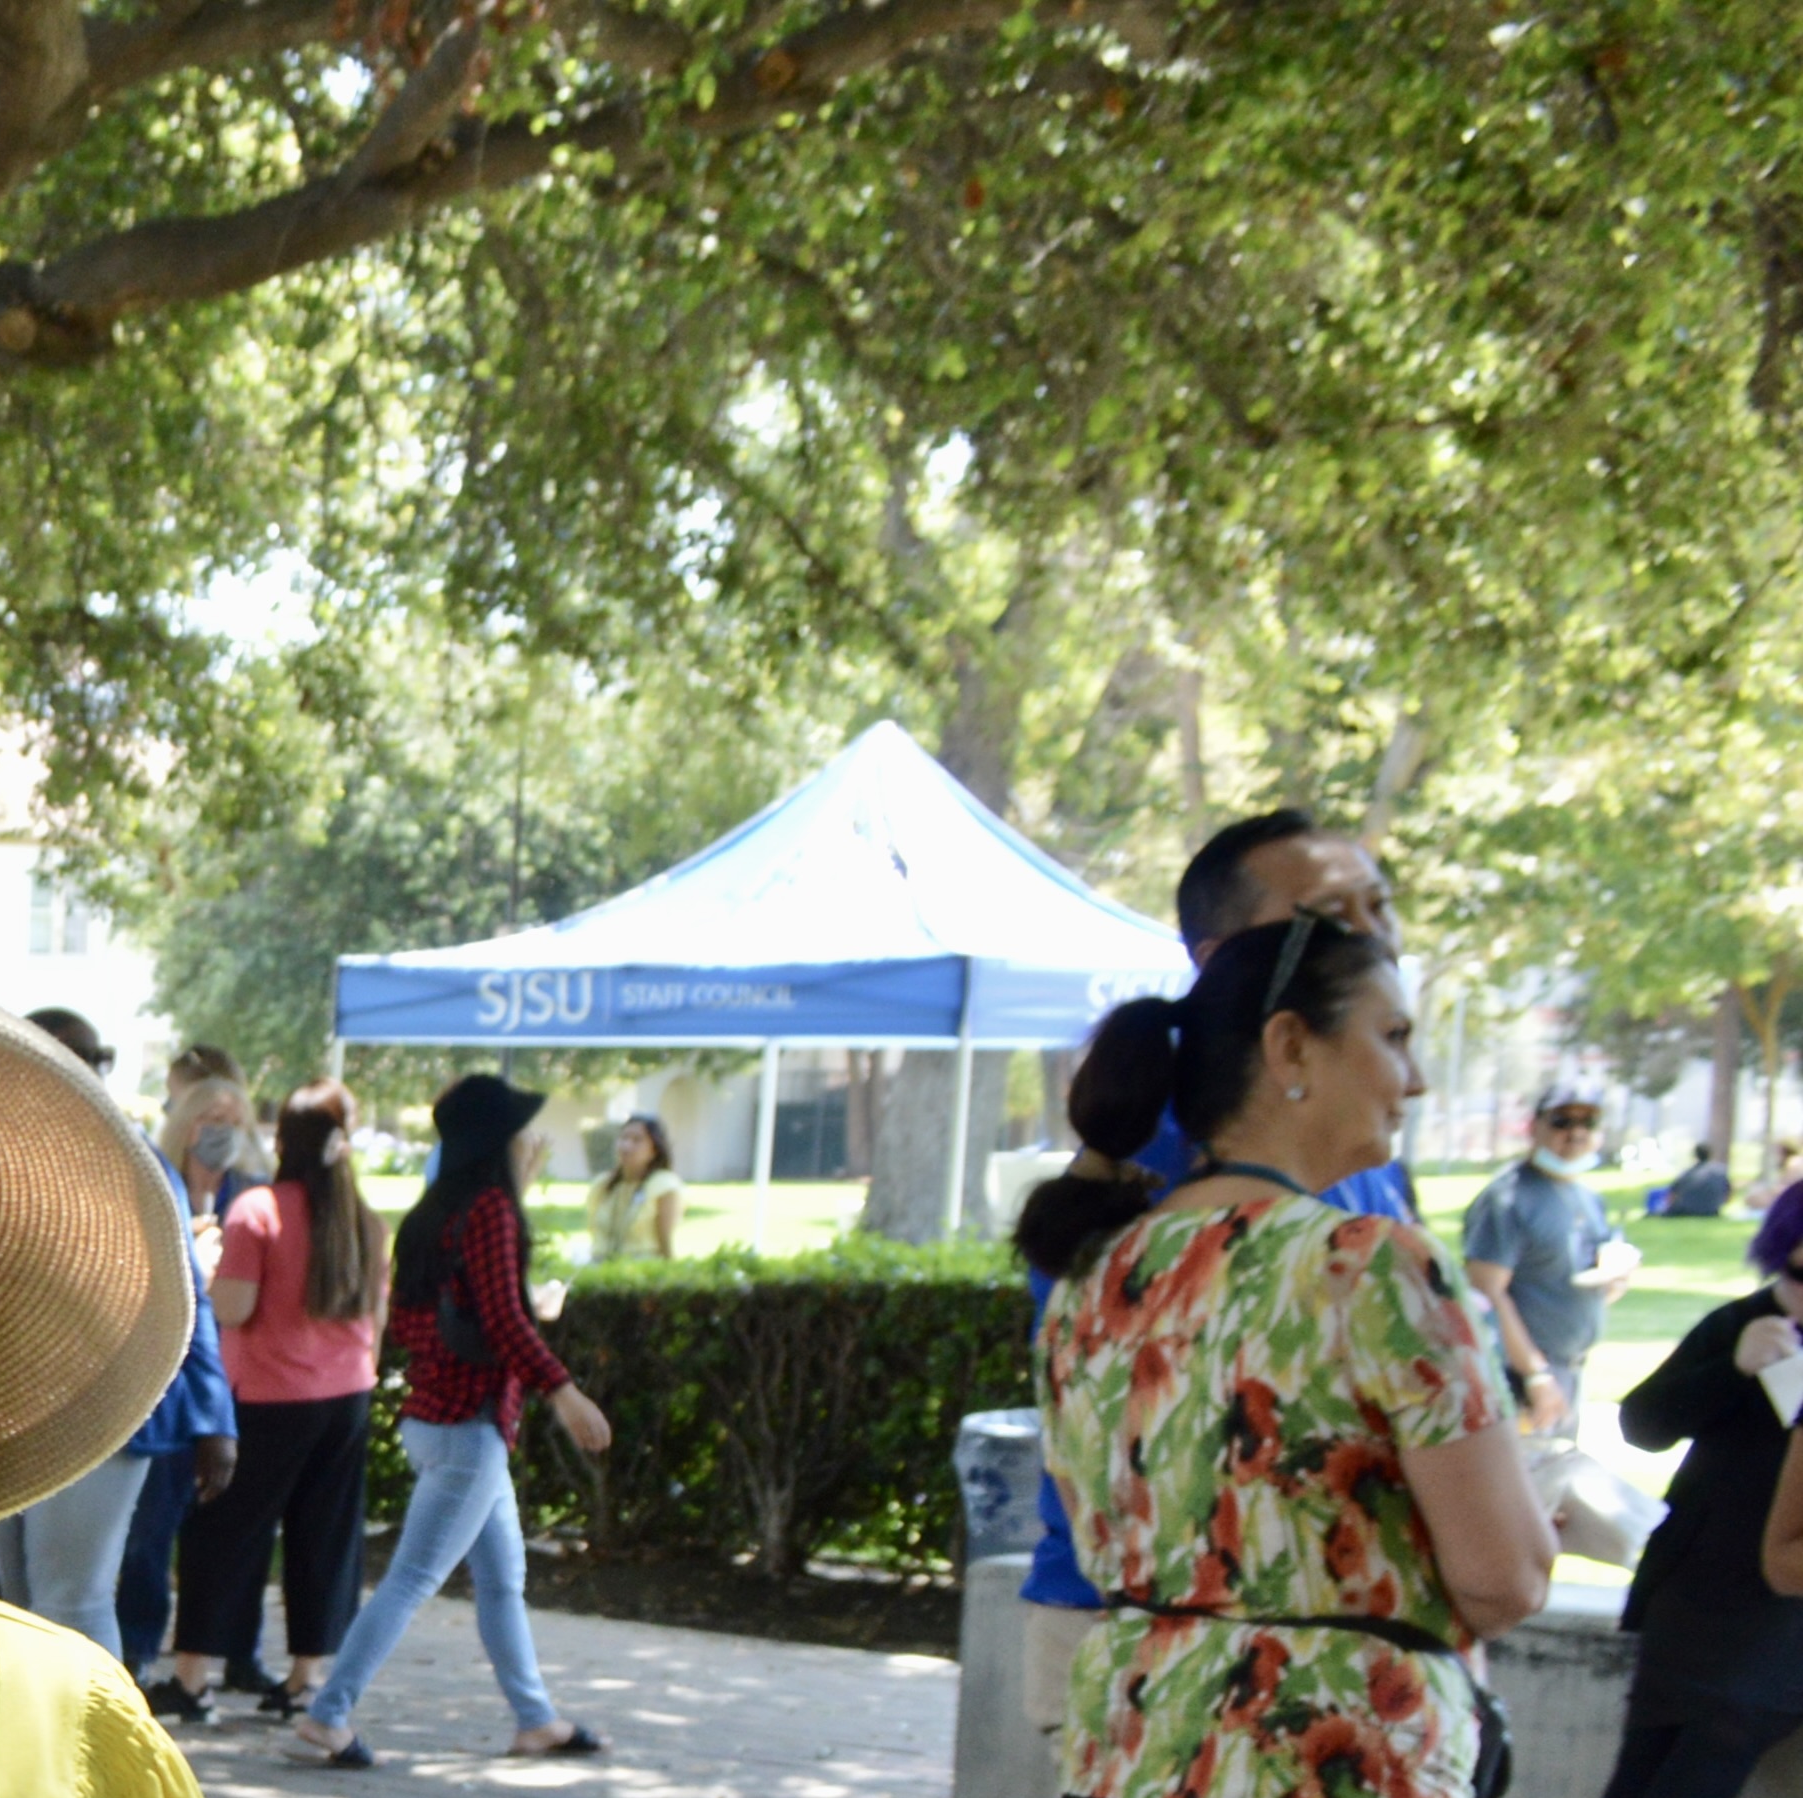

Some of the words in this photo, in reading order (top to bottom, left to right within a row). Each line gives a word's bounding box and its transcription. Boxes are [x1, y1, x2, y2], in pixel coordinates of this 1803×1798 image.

[476, 971, 594, 1033] SJSU
[622, 984, 689, 1009] STAFF
[694, 983, 794, 1009] COUNCIL
